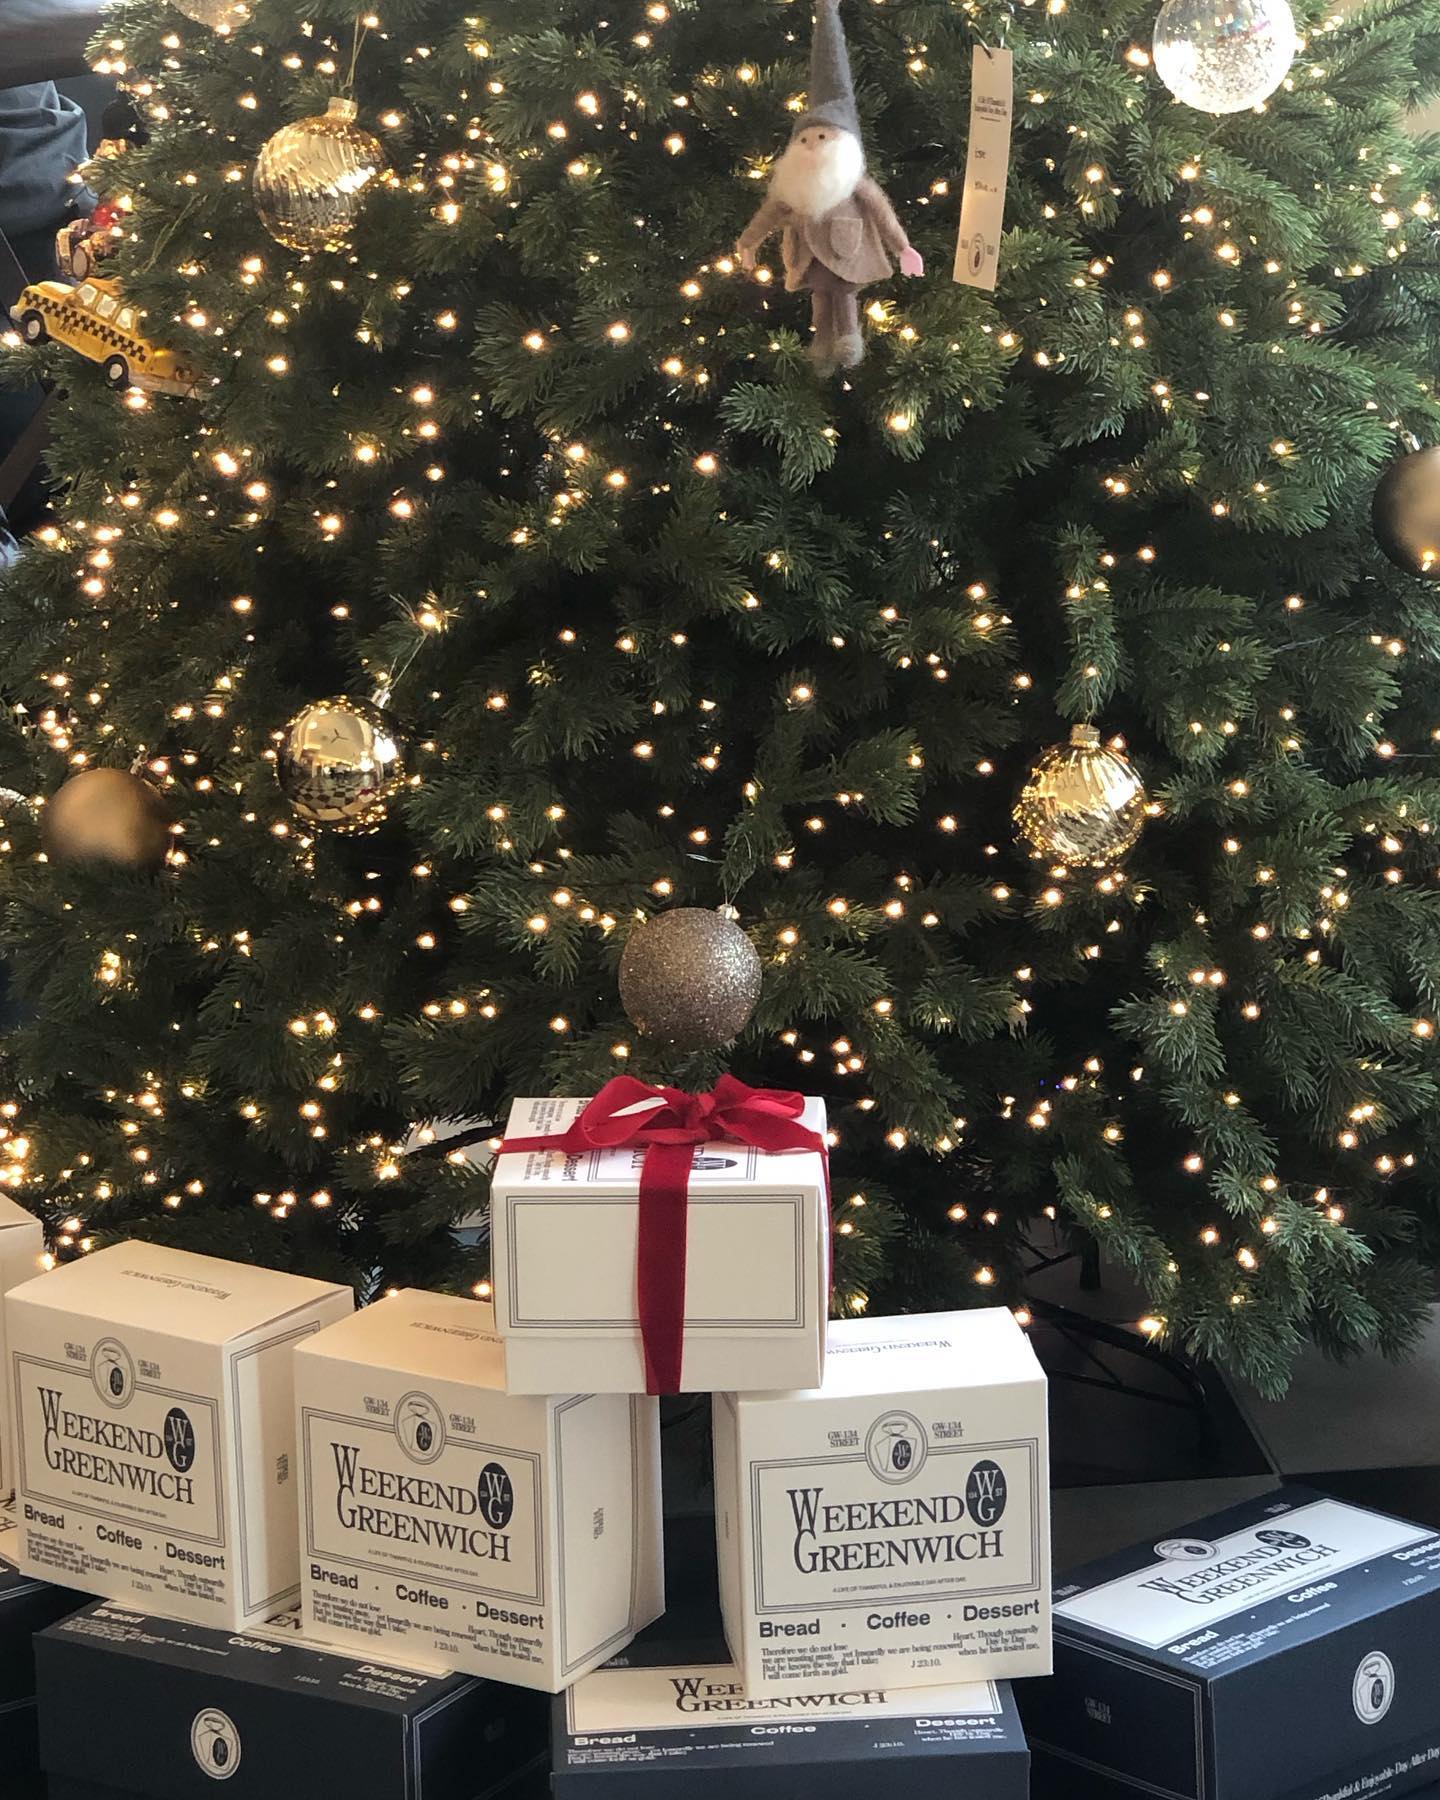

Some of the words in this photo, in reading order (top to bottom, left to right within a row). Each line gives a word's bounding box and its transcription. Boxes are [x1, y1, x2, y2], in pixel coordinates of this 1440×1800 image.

[37, 1387, 164, 1459] WEEKEND
[828, 1430, 858, 1440] GW-134
[830, 1438, 860, 1448] STREET
[932, 1420, 962, 1430] GW-134
[934, 1428, 965, 1440] STREET
[44, 1427, 194, 1504] GREENWICH
[330, 1442, 478, 1516] WEEKEND
[336, 1485, 512, 1562] GREENWICH
[786, 1488, 965, 1538] WEEKEND
[24, 1504, 64, 1530] Bread
[96, 1525, 142, 1550] Coffee
[166, 1542, 225, 1570] Dessert
[794, 1529, 1004, 1574] GREENWICH
[1137, 1545, 1283, 1595] WEEKEND
[1176, 1544, 1340, 1604] GREENWICH
[1288, 1582, 1338, 1603] Coffee
[310, 1564, 358, 1590] Bread
[396, 1584, 449, 1610] Coffee
[476, 1601, 544, 1630] Dessert
[759, 1618, 820, 1638] Bread
[866, 1610, 930, 1630] Coffee
[962, 1600, 1040, 1622] Dessert
[90, 1607, 144, 1624] Bread
[228, 1636, 282, 1654] Coffee
[356, 1664, 428, 1688] Dessert
[1168, 1630, 1220, 1654] Bread
[676, 1690, 888, 1712] GREENWICH
[574, 1734, 636, 1746] Bread
[750, 1724, 816, 1736] Coffee
[916, 1718, 996, 1727] Dessert
